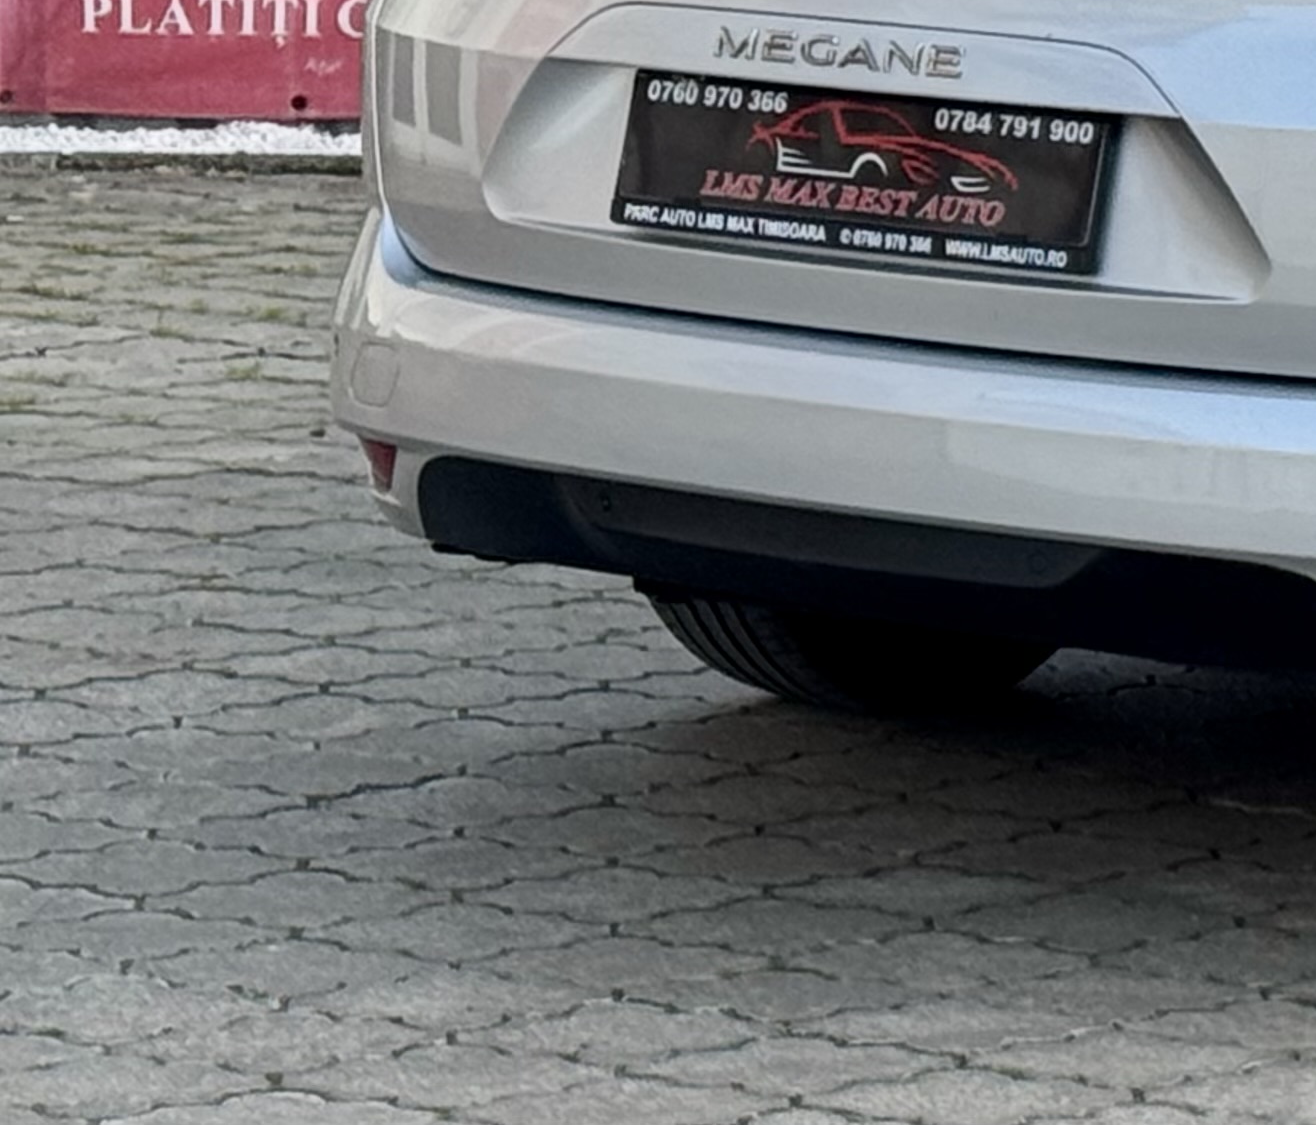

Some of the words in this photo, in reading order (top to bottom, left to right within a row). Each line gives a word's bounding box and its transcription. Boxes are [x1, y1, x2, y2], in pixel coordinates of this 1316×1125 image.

[712, 25, 967, 80] MEGANE
[647, 79, 699, 106] 0760
[702, 84, 743, 110] 970
[747, 89, 789, 114] 366
[933, 107, 992, 135] 0784
[999, 113, 1042, 140] 791
[1048, 118, 1095, 144] 900
[700, 169, 764, 200] LMS
[764, 177, 838, 210] MAX
[834, 184, 918, 218] BEST
[914, 193, 1007, 227] AUTO
[623, 202, 660, 222] PARC
[660, 207, 697, 227] AUTO
[698, 211, 724, 231] LMS
[726, 214, 755, 235] MAX
